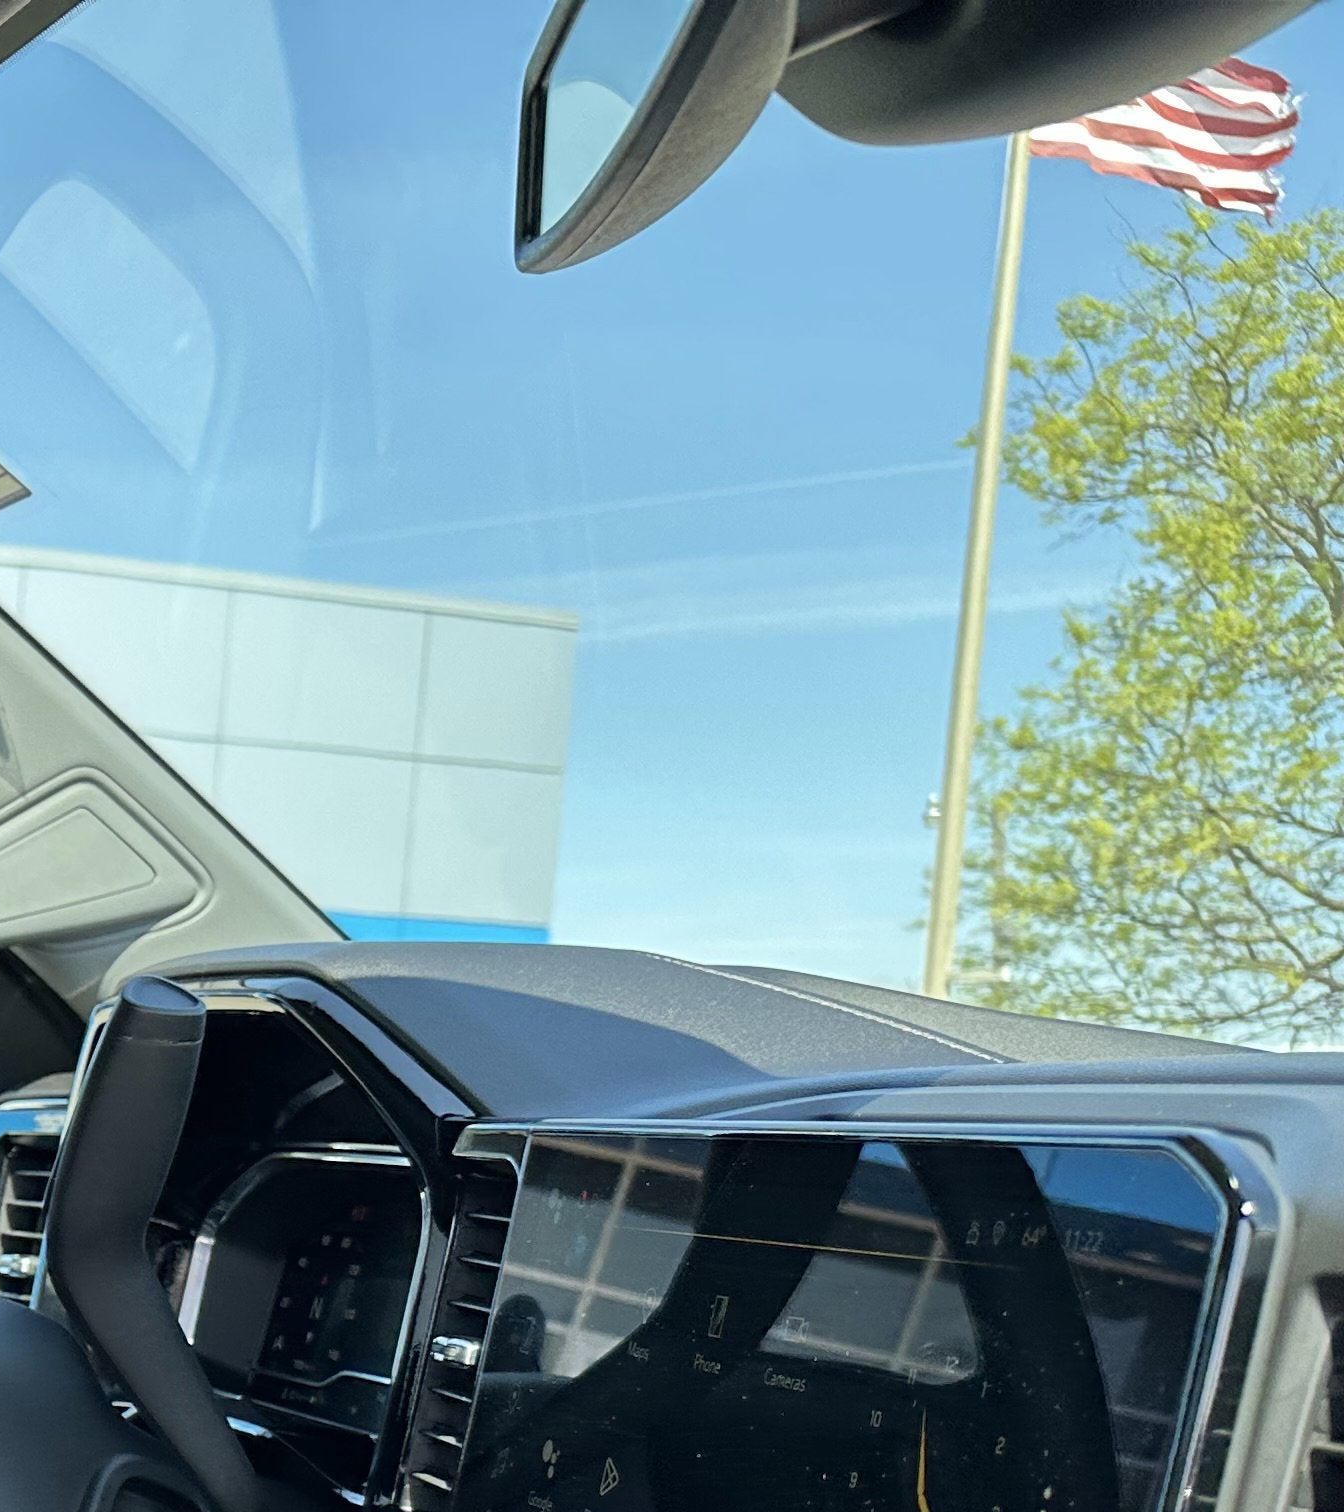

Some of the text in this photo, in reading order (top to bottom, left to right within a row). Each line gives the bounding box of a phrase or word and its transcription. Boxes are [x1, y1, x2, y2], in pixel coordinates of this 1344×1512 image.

[693, 1353, 721, 1376] Phone
[763, 1367, 806, 1392] Cameras
[869, 1410, 882, 1428] 10
[995, 1436, 1006, 1455] 2
[849, 1471, 858, 1489] 9
